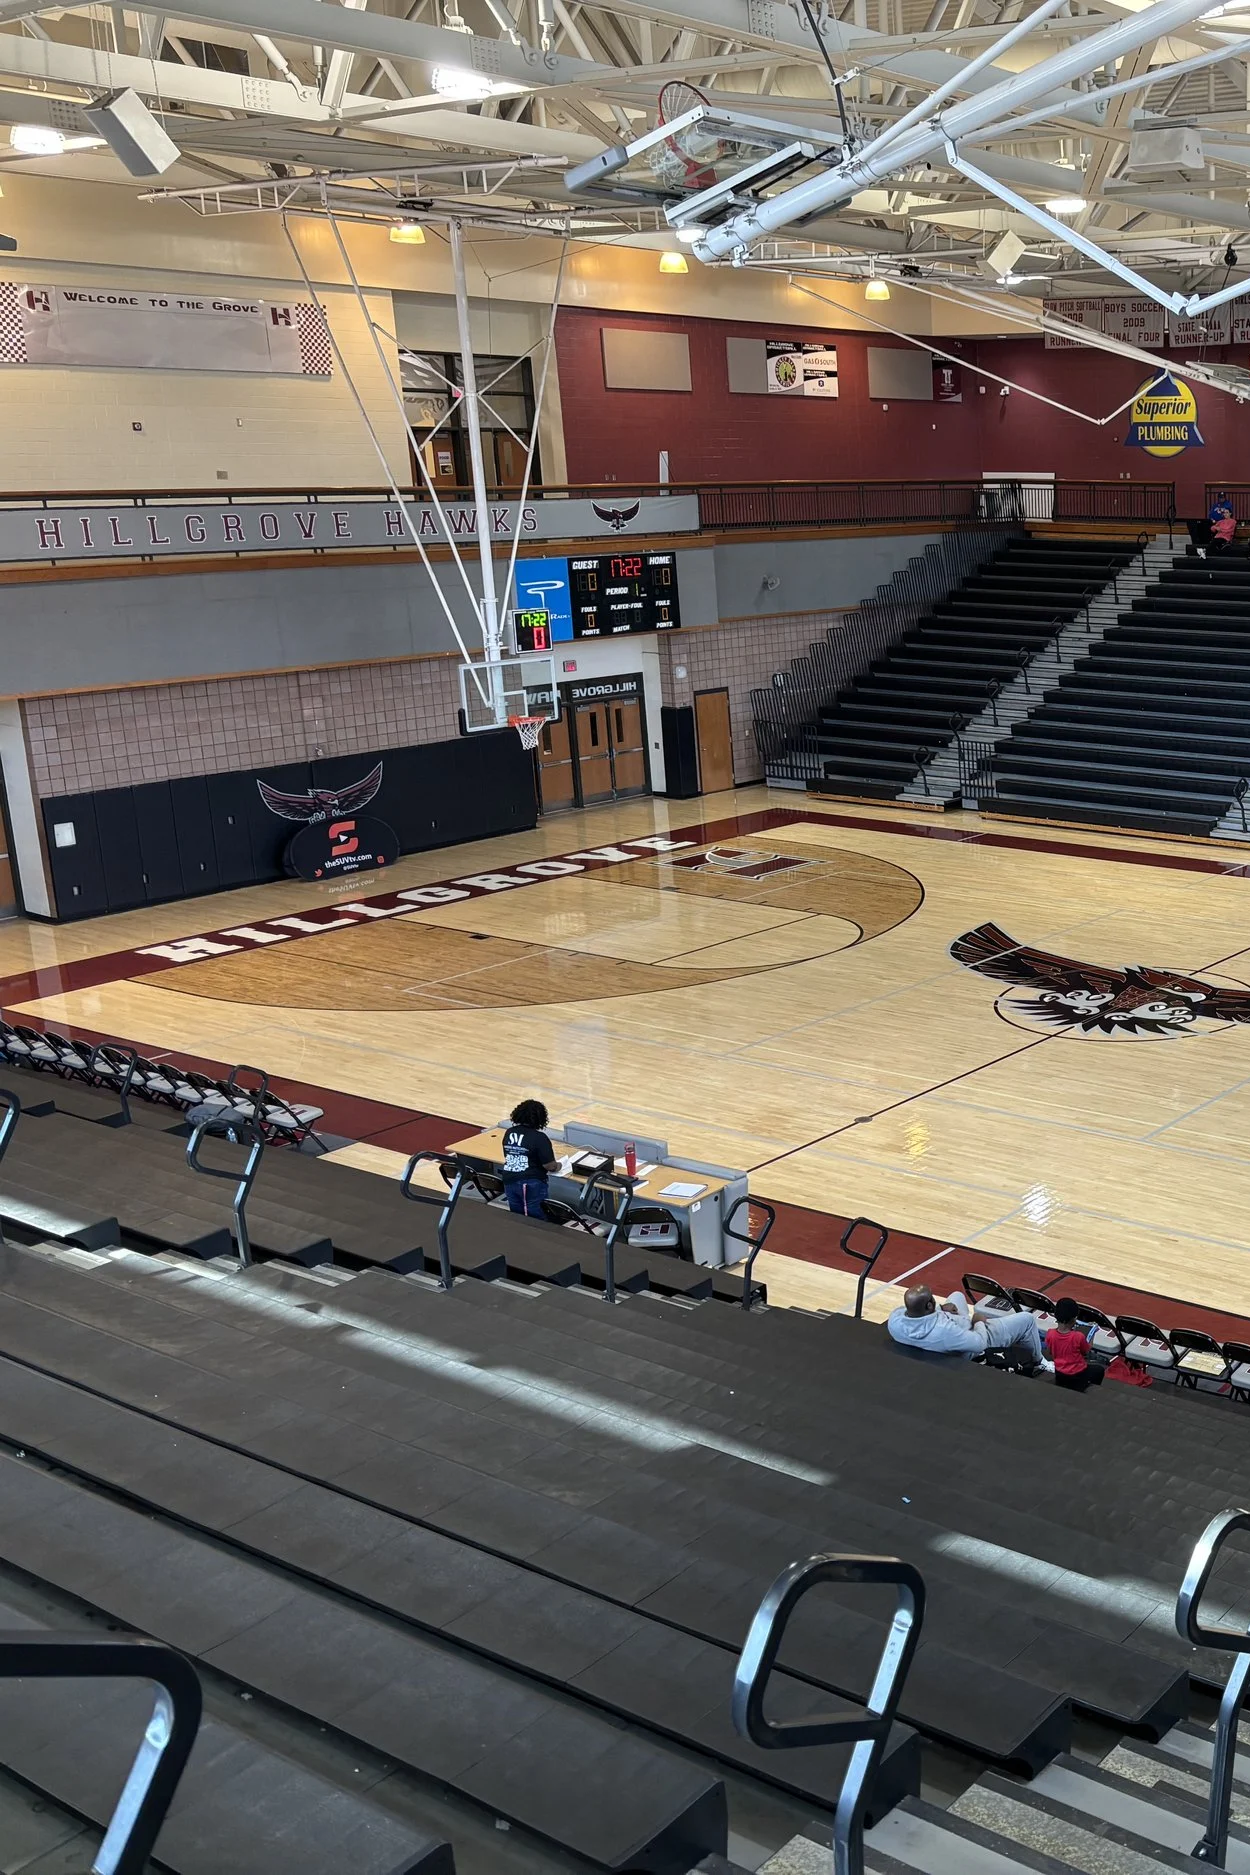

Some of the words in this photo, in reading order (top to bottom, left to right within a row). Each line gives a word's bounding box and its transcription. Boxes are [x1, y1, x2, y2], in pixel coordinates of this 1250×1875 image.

[63, 292, 139, 305] WELCOME
[150, 299, 168, 308] TO
[176, 300, 204, 310] THE
[212, 301, 259, 314] GROVE
[1060, 301, 1074, 311] PITCH
[1077, 300, 1101, 311] SOFTBALL
[1104, 303, 1126, 313] BOYS
[1131, 303, 1164, 313] SOCCER
[1123, 318, 1145, 328] 2009
[1178, 322, 1195, 332] STATE
[1138, 333, 1160, 342] FOUR
[1175, 332, 1224, 344] RUNNER-UP
[1136, 398, 1191, 420] Superior
[1138, 425, 1189, 440] PLUMBING
[35, 511, 352, 549] HILLGROVE
[384, 508, 537, 537] HAWKS
[572, 560, 599, 570] GUEST
[649, 556, 671, 565] HOME
[611, 557, 642, 578] 17:22
[605, 587, 629, 596] PERIOD
[581, 605, 597, 613] FOULS
[610, 602, 644, 611] PLAYER-FOUL
[521, 612, 547, 628] 17:22
[656, 621, 674, 629] POINTS
[581, 628, 600, 636] POINTS
[612, 624, 631, 633] MATCH
[324, 853, 373, 869] theSUVtv.com
[136, 836, 697, 964] HILLGROVE
